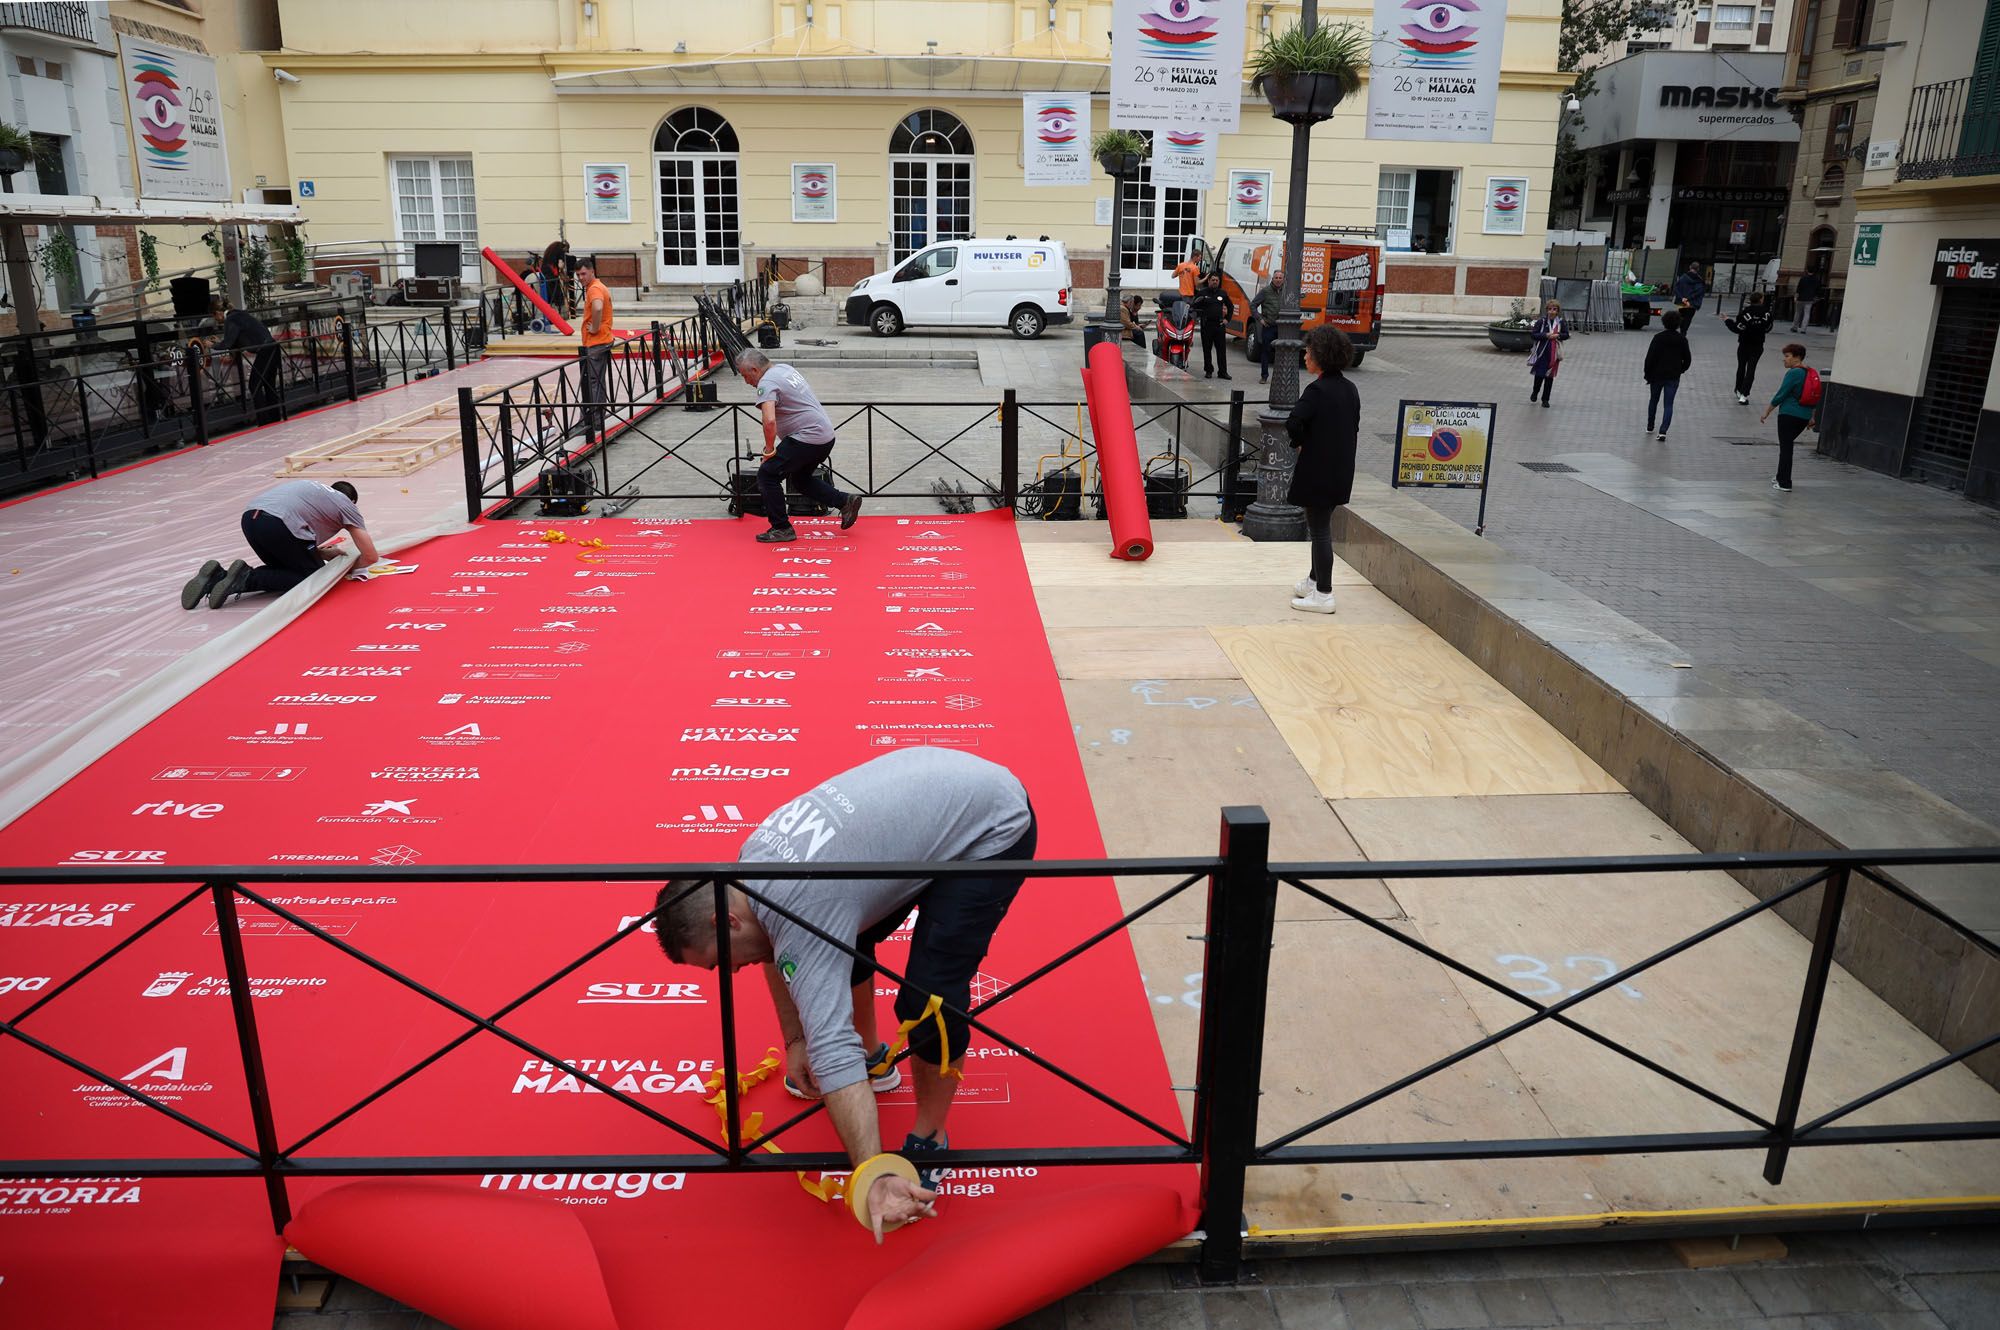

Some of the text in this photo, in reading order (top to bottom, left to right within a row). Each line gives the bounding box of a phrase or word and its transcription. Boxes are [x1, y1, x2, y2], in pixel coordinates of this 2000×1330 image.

[1134, 65, 1155, 83] 26
[1171, 67, 1218, 76] FESTIVAL DE
[1393, 75, 1413, 93] 26
[1429, 76, 1465, 84] FESTIVAL
[1428, 83, 1475, 94] MÁLAGA
[185, 86, 204, 113] 26
[189, 114, 217, 125] FESTIVAL DE
[1698, 114, 1775, 125] supermercados
[974, 252, 1022, 260] MULTISER
[1937, 246, 1979, 263] mister
[1456, 410, 1481, 419] LOCAL
[1435, 418, 1468, 426] MALAGA
[1400, 462, 1483, 472] PROHIBIDO ESTACIONAR DESDE
[1400, 471, 1411, 479] LAS
[1436, 472, 1446, 481] DEL
[1447, 473, 1457, 481] DIA
[1465, 473, 1472, 481] AL
[782, 557, 832, 565] rtve
[749, 605, 833, 613] málaga
[385, 621, 448, 631] rtve
[301, 669, 403, 677] MÁLAGA
[728, 669, 797, 680] rtve
[272, 692, 378, 704] málaga
[715, 697, 789, 705] SUR
[680, 732, 797, 741] MÁLAGA
[671, 763, 790, 779] málaga
[131, 800, 224, 819] rtve
[316, 816, 382, 824] Fundación
[402, 816, 443, 824] Caixa"
[68, 850, 168, 861] SUR
[100, 903, 136, 912] DE
[198, 976, 328, 987] Ayutamiento
[187, 987, 284, 998] de Mlaga
[585, 982, 702, 998] SUR
[522, 1059, 716, 1072] FESTIVAL DE
[73, 1082, 213, 1092] Junta Andalucía
[83, 1094, 131, 1103] Consejería
